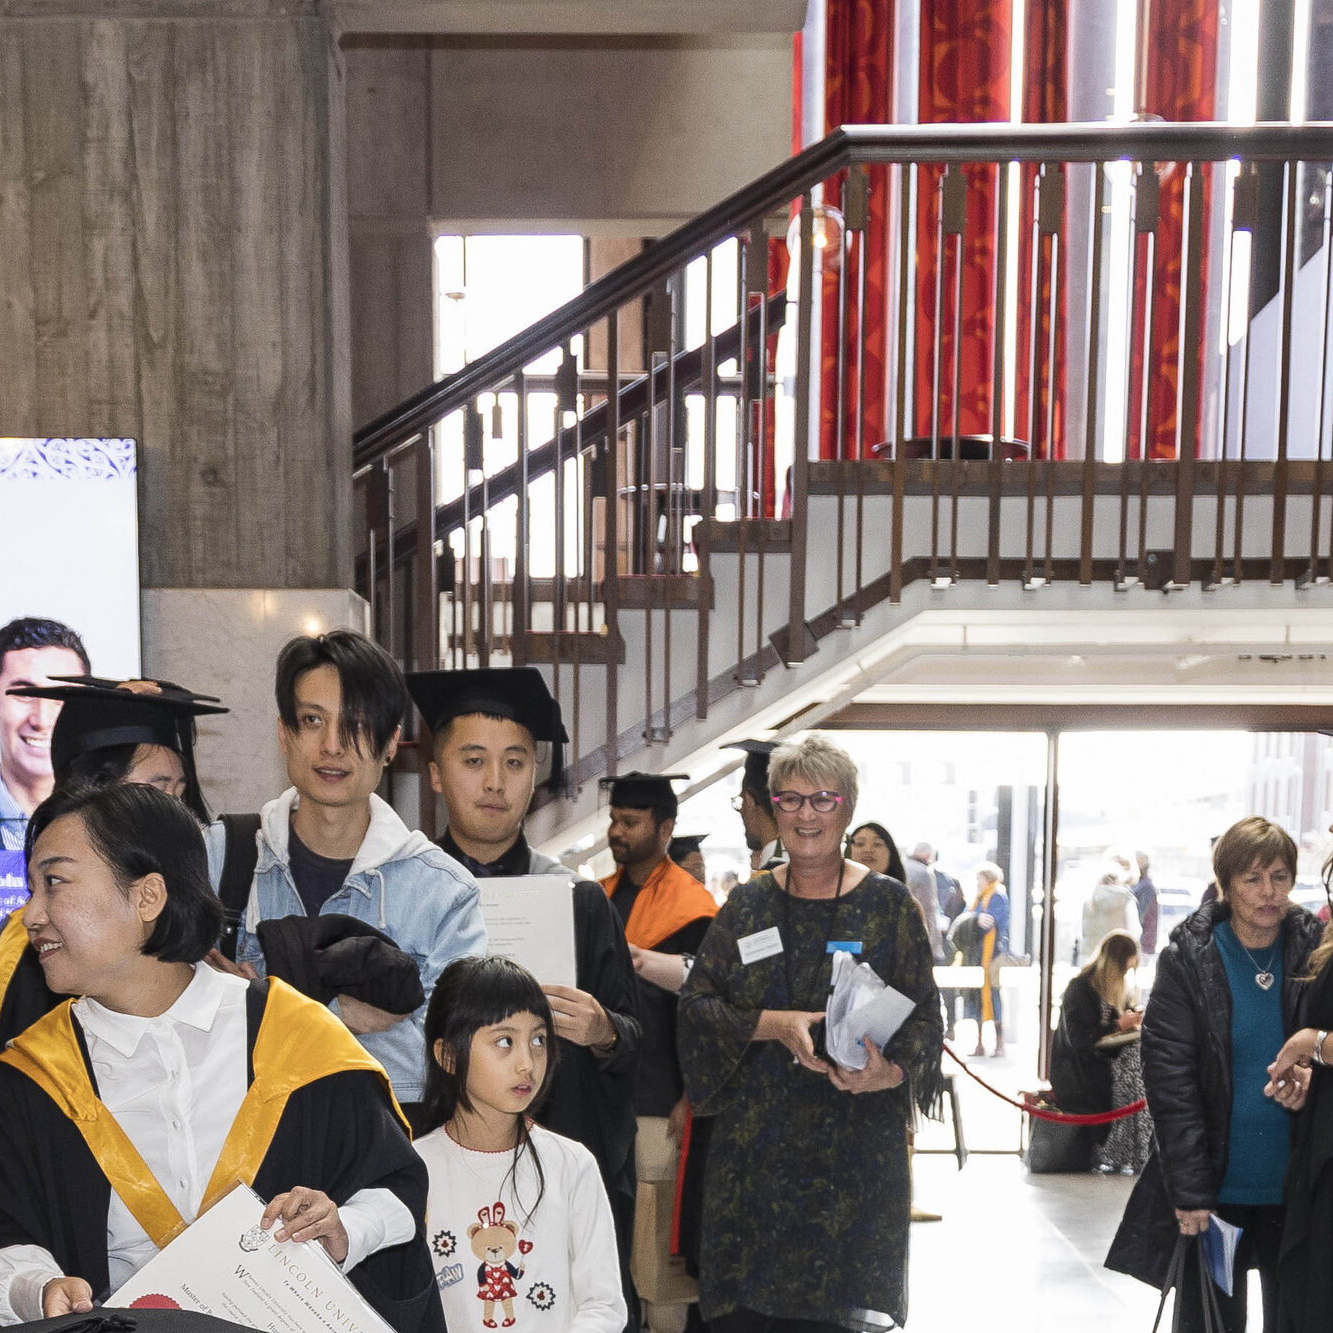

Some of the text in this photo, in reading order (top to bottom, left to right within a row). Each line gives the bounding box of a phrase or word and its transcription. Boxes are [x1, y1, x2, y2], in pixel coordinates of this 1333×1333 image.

[267, 1242, 323, 1299] LINCOLN
[179, 1283, 201, 1305] Master
[198, 1301, 208, 1312] of
